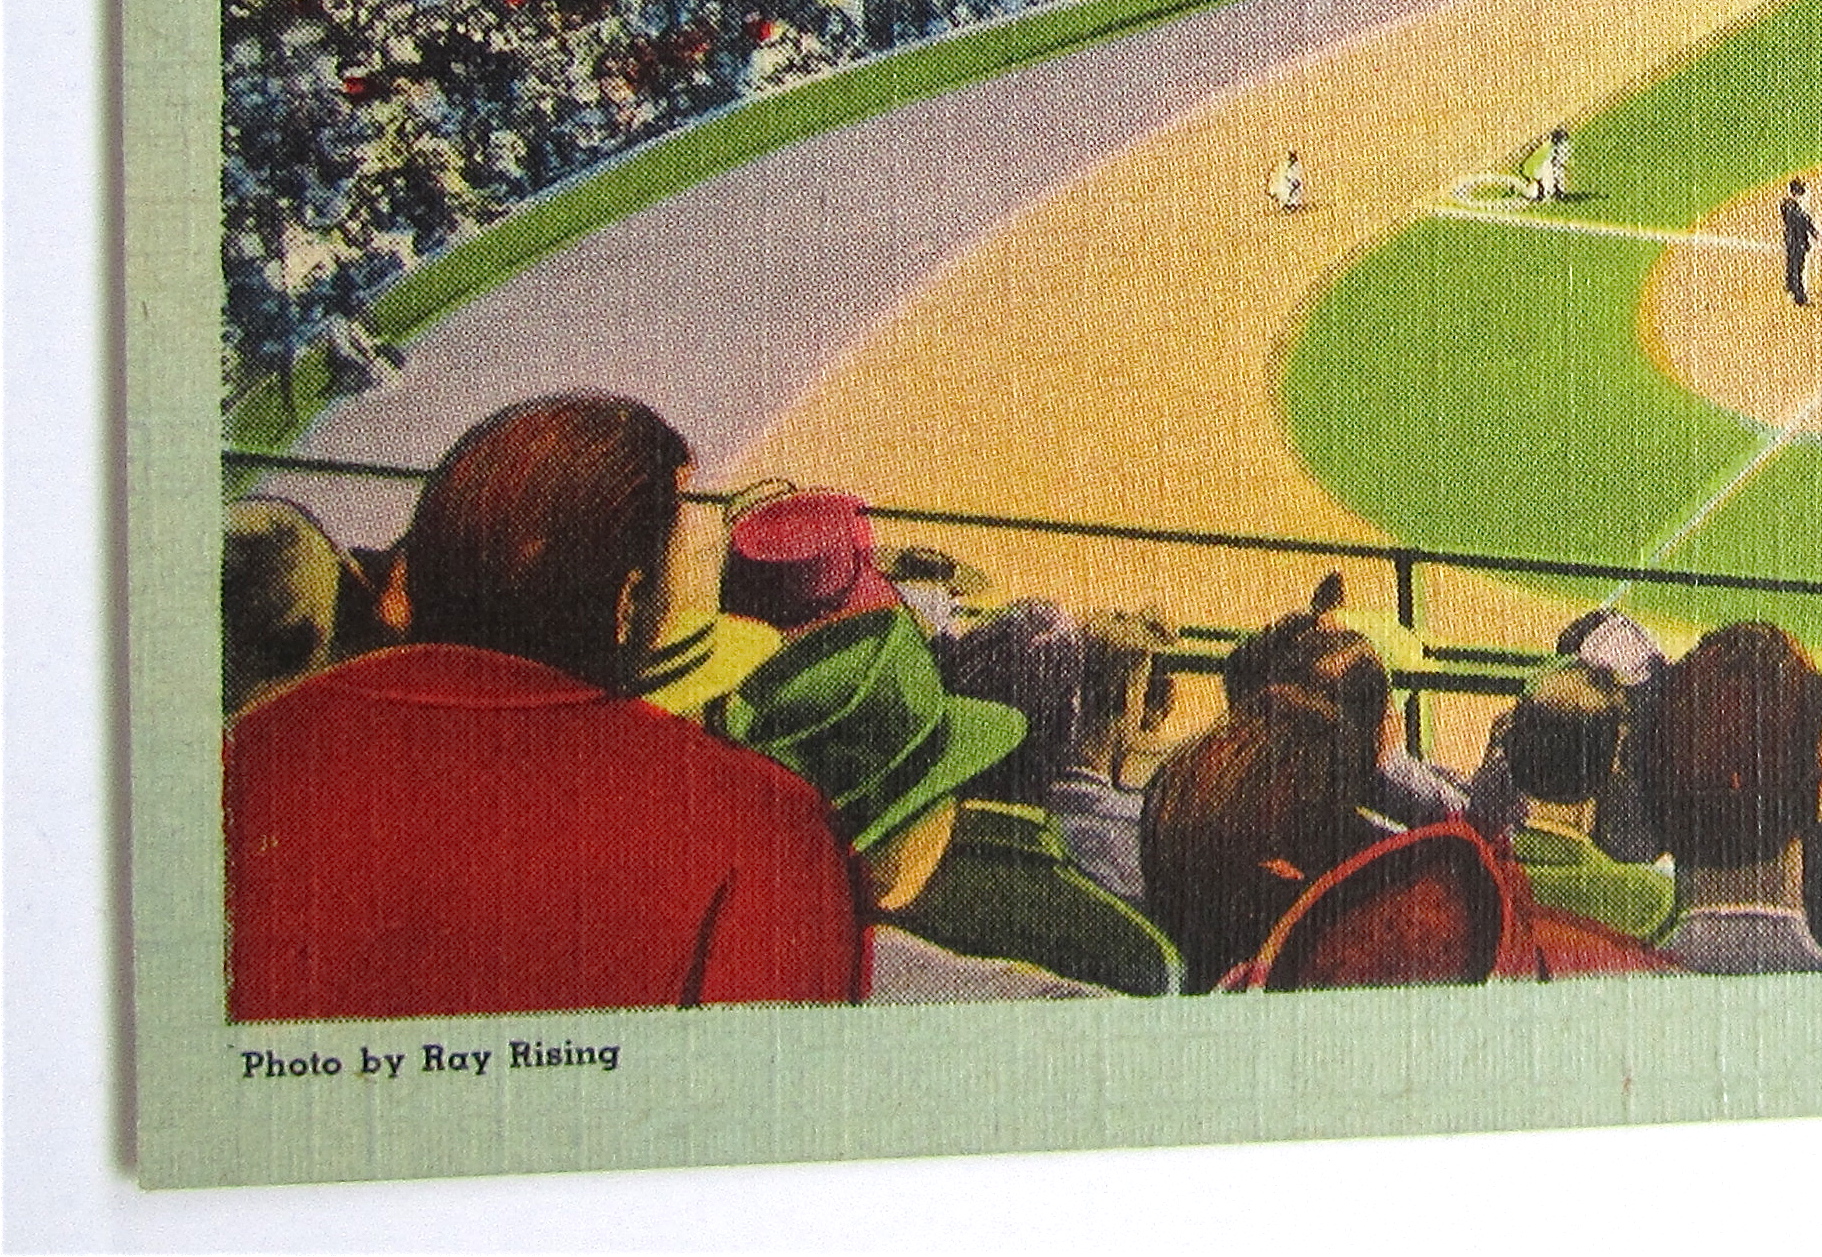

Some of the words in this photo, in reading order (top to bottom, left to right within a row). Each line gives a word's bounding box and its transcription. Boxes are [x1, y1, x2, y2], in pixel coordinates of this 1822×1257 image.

[241, 1050, 342, 1079] Photo
[360, 1046, 405, 1079] by
[421, 1043, 492, 1076] Ray
[508, 1040, 621, 1072] Rising
